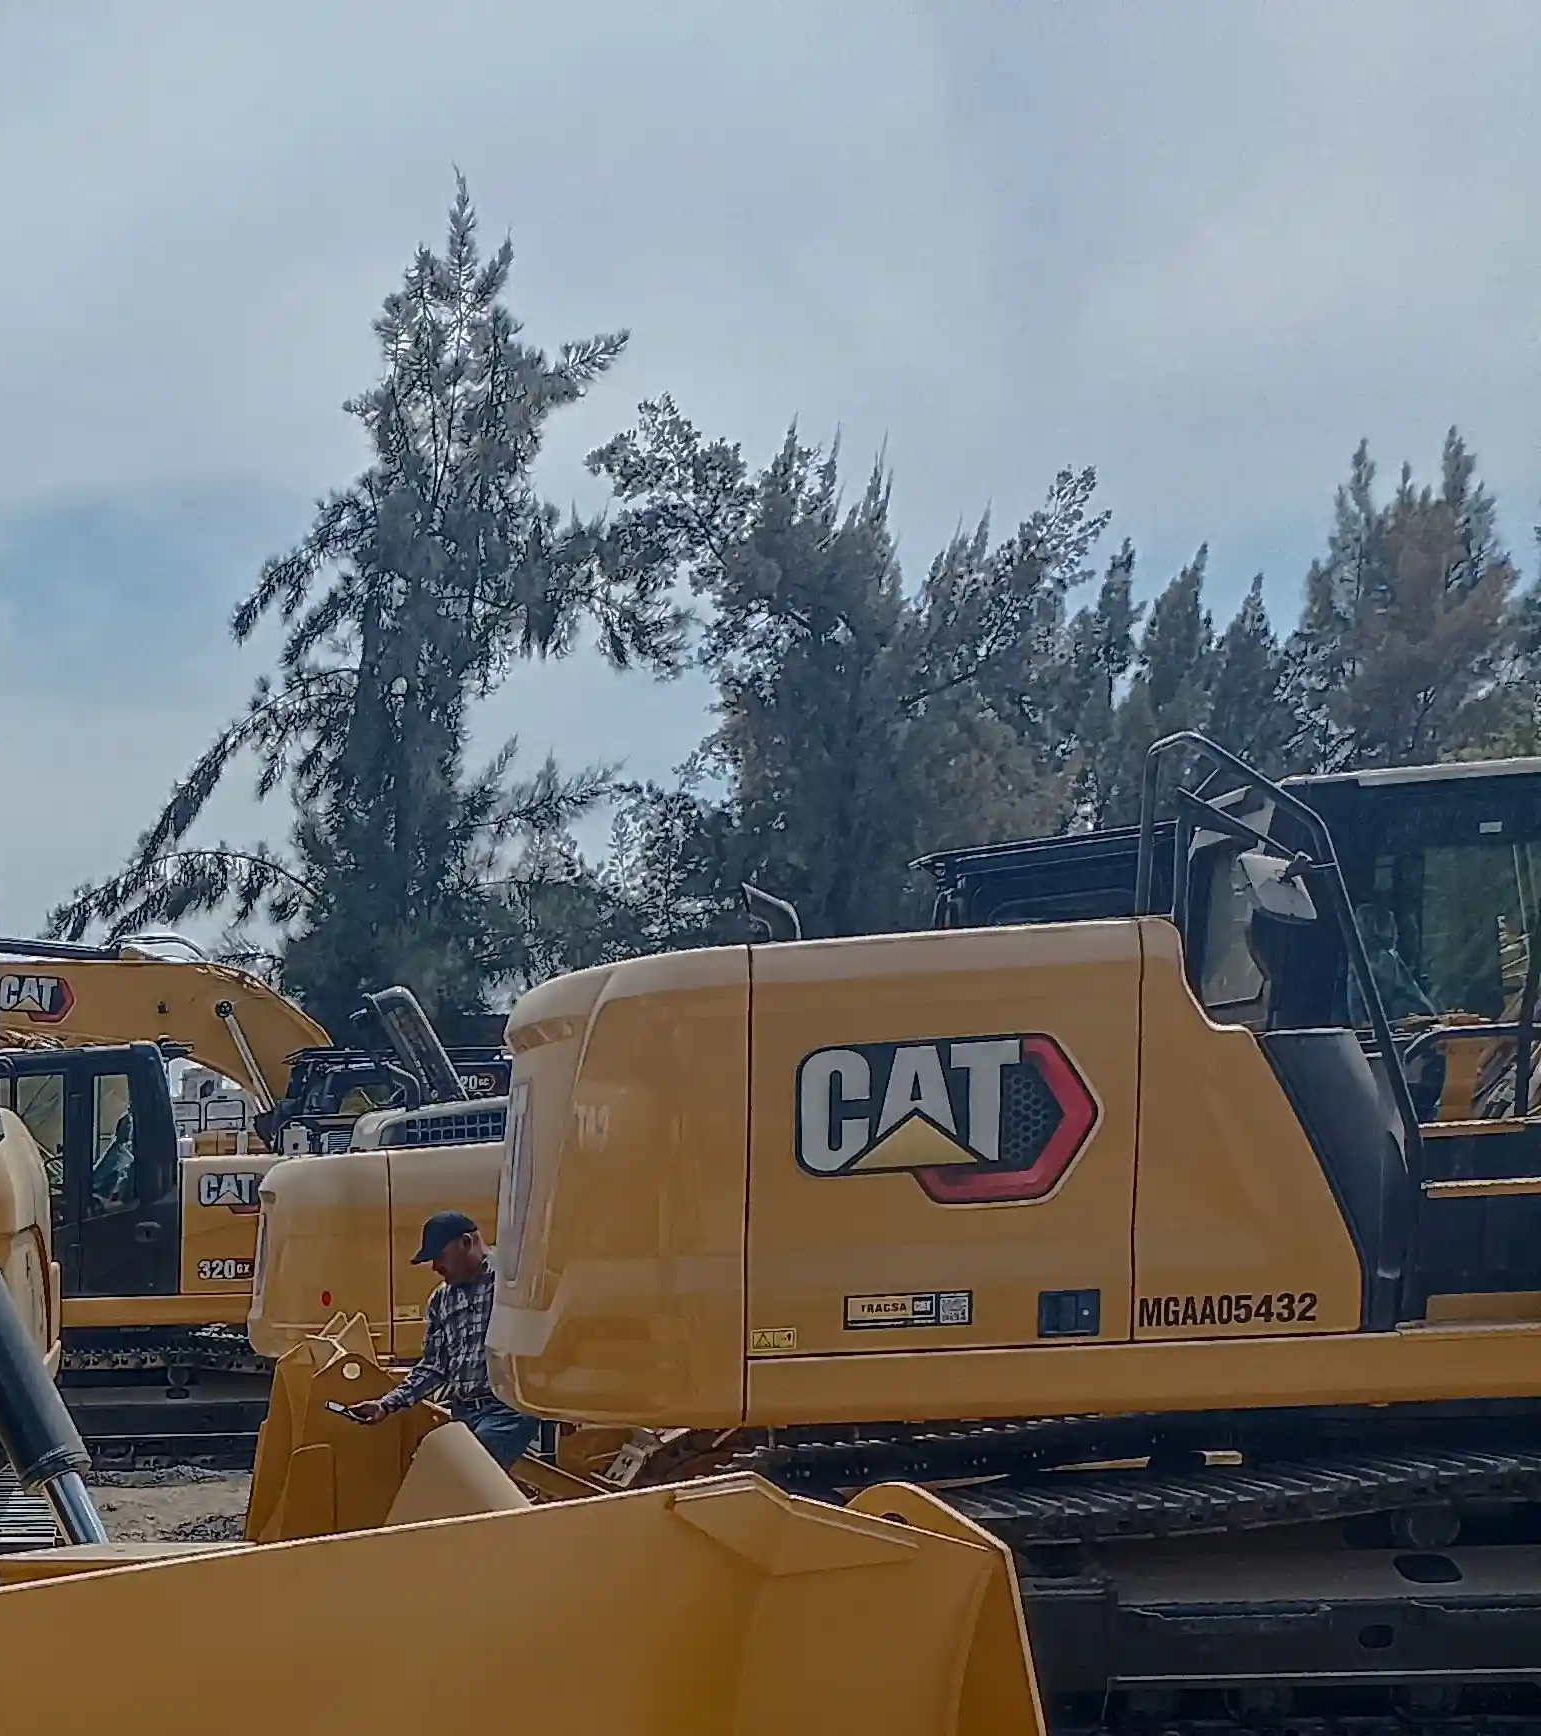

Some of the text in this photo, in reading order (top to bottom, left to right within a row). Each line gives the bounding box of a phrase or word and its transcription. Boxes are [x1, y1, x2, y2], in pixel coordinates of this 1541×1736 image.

[0, 976, 58, 1012] CAT
[800, 1038, 1021, 1172] CAT
[199, 1173, 255, 1205] CAT
[861, 1302, 907, 1314] TRACSA
[1138, 1292, 1318, 1328] MGAA05432
